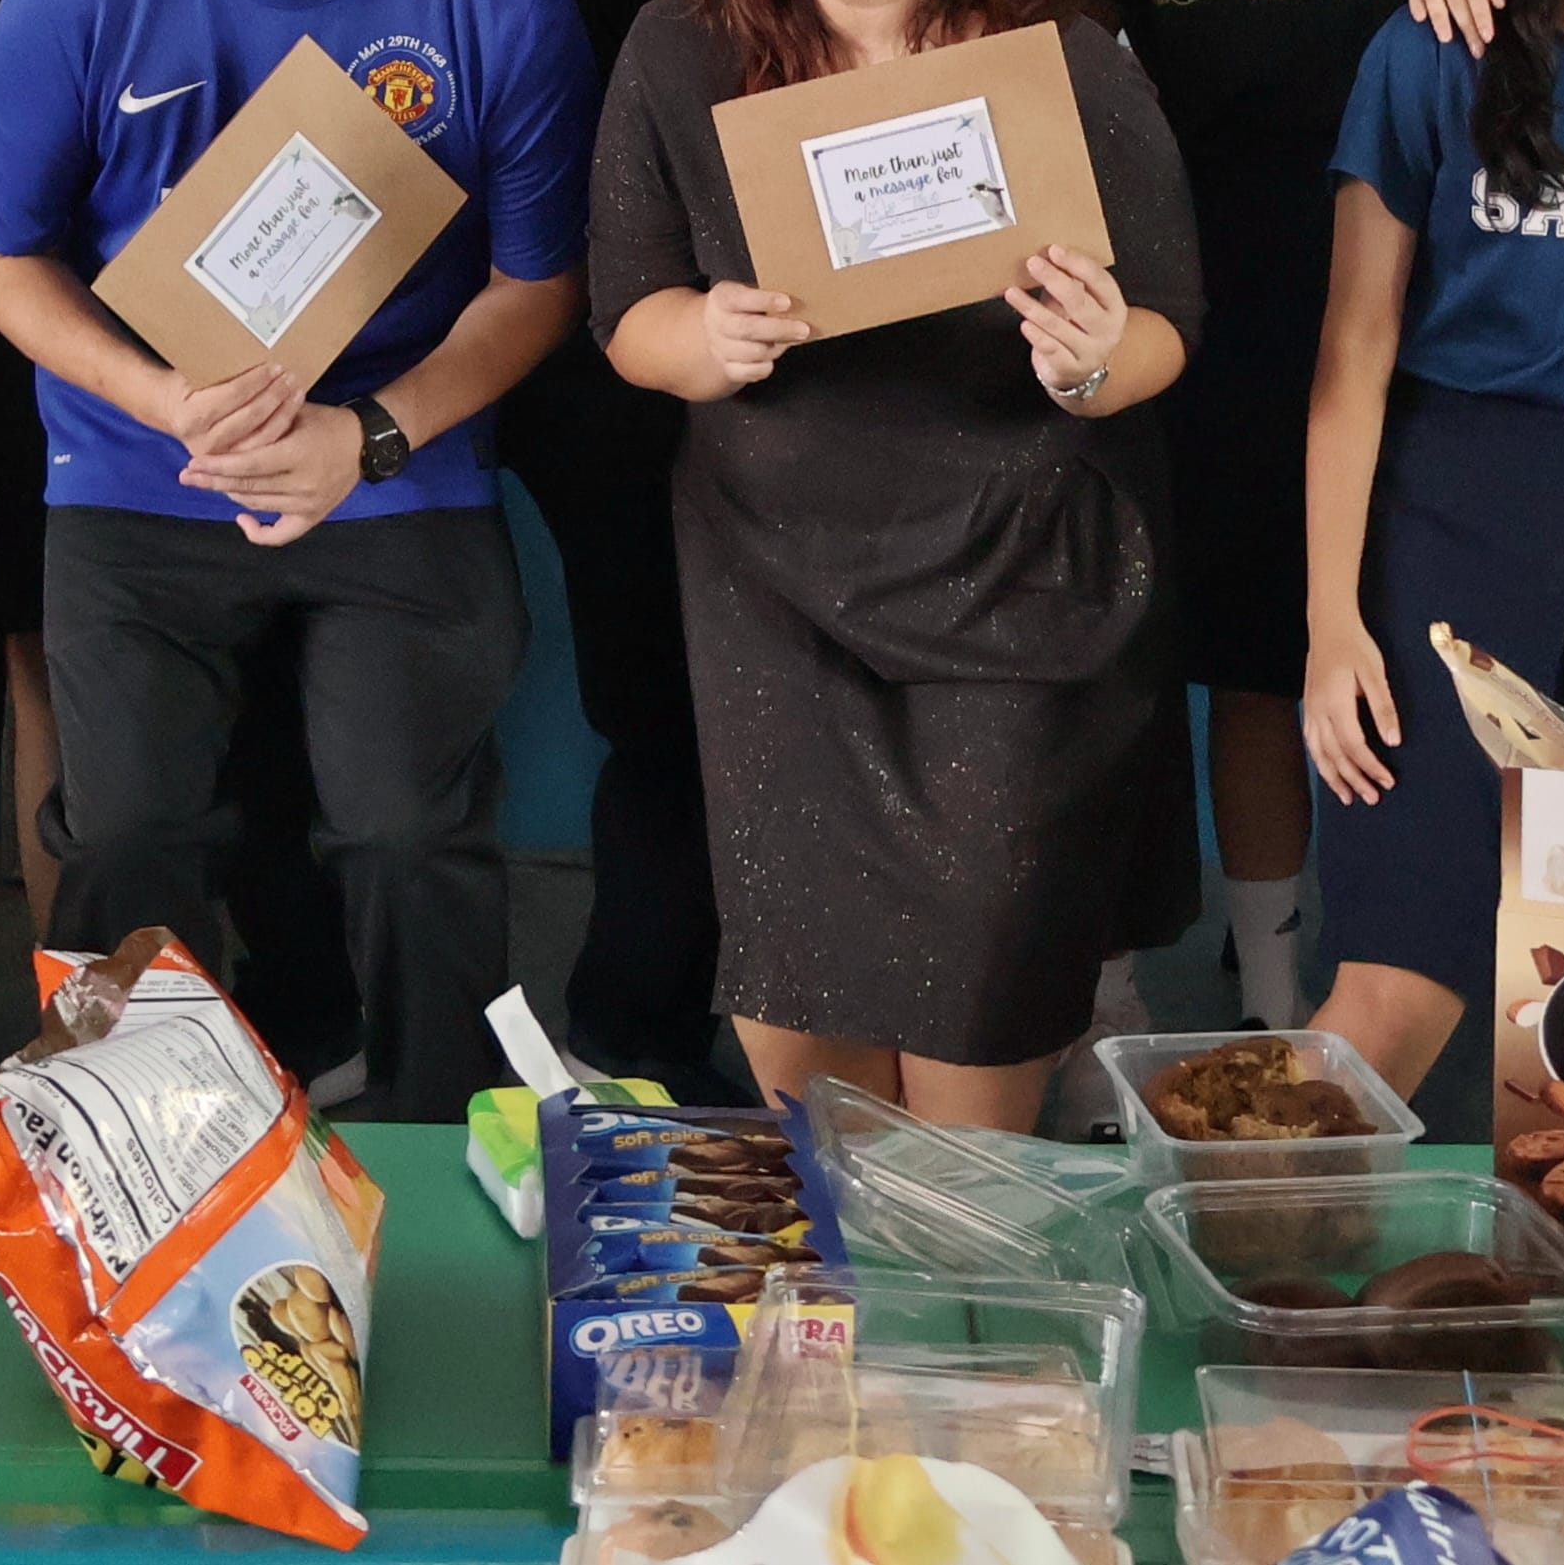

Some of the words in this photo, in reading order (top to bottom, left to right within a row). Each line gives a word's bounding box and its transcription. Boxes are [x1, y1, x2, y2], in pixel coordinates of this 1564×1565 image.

[358, 38, 385, 61] MAY
[388, 35, 421, 50] 29TH
[421, 43, 448, 69] 1968
[889, 153, 931, 175] than
[930, 142, 964, 168] just
[854, 190, 866, 203] a
[869, 172, 934, 200] message
[936, 166, 964, 185] for
[258, 204, 290, 237] than
[284, 177, 311, 213] just
[248, 268, 260, 280] a
[258, 218, 301, 269] message
[299, 196, 321, 221] for
[613, 1131, 653, 1149] soft
[659, 1131, 708, 1144] cake
[126, 1137, 173, 1224] Calories
[639, 1231, 682, 1244] soft
[616, 1275, 660, 1295] soft
[574, 1310, 704, 1352] OREO
